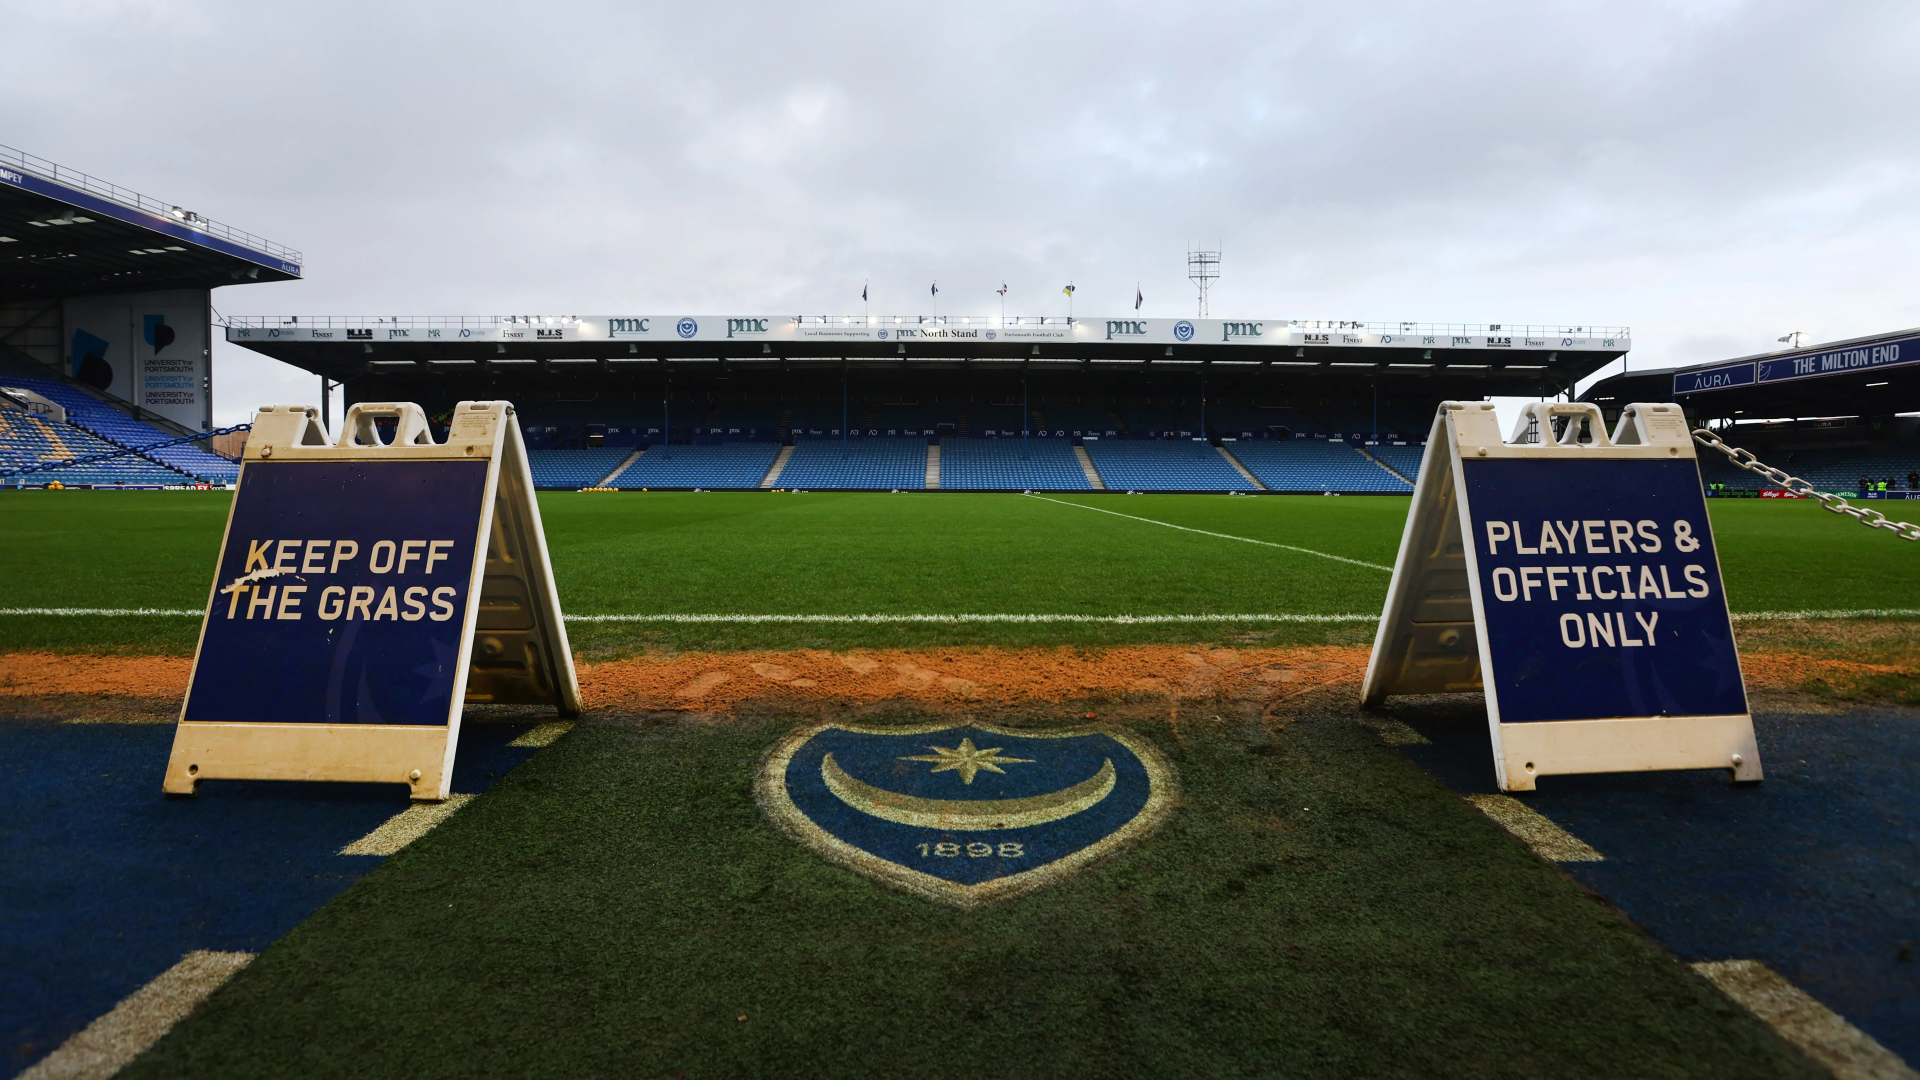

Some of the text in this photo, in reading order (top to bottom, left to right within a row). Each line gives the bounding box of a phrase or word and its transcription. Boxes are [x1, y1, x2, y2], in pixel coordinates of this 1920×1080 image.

[389, 329, 410, 339] pmc
[608, 318, 650, 338] pmc
[726, 318, 768, 338] pmc
[896, 329, 978, 340] pmc North Stand
[1106, 321, 1147, 340] pmc
[1222, 322, 1263, 341] pmc
[1452, 336, 1472, 346] pmc
[1793, 344, 1900, 375] THE MILTON END
[1486, 519, 1700, 555] PLAYERS &
[244, 540, 454, 574] KEEP OFF
[1492, 564, 1710, 602] OFFICIALS
[226, 585, 456, 622] THE GRASS
[1560, 611, 1659, 648] ONLY
[916, 841, 1025, 859] 1898
